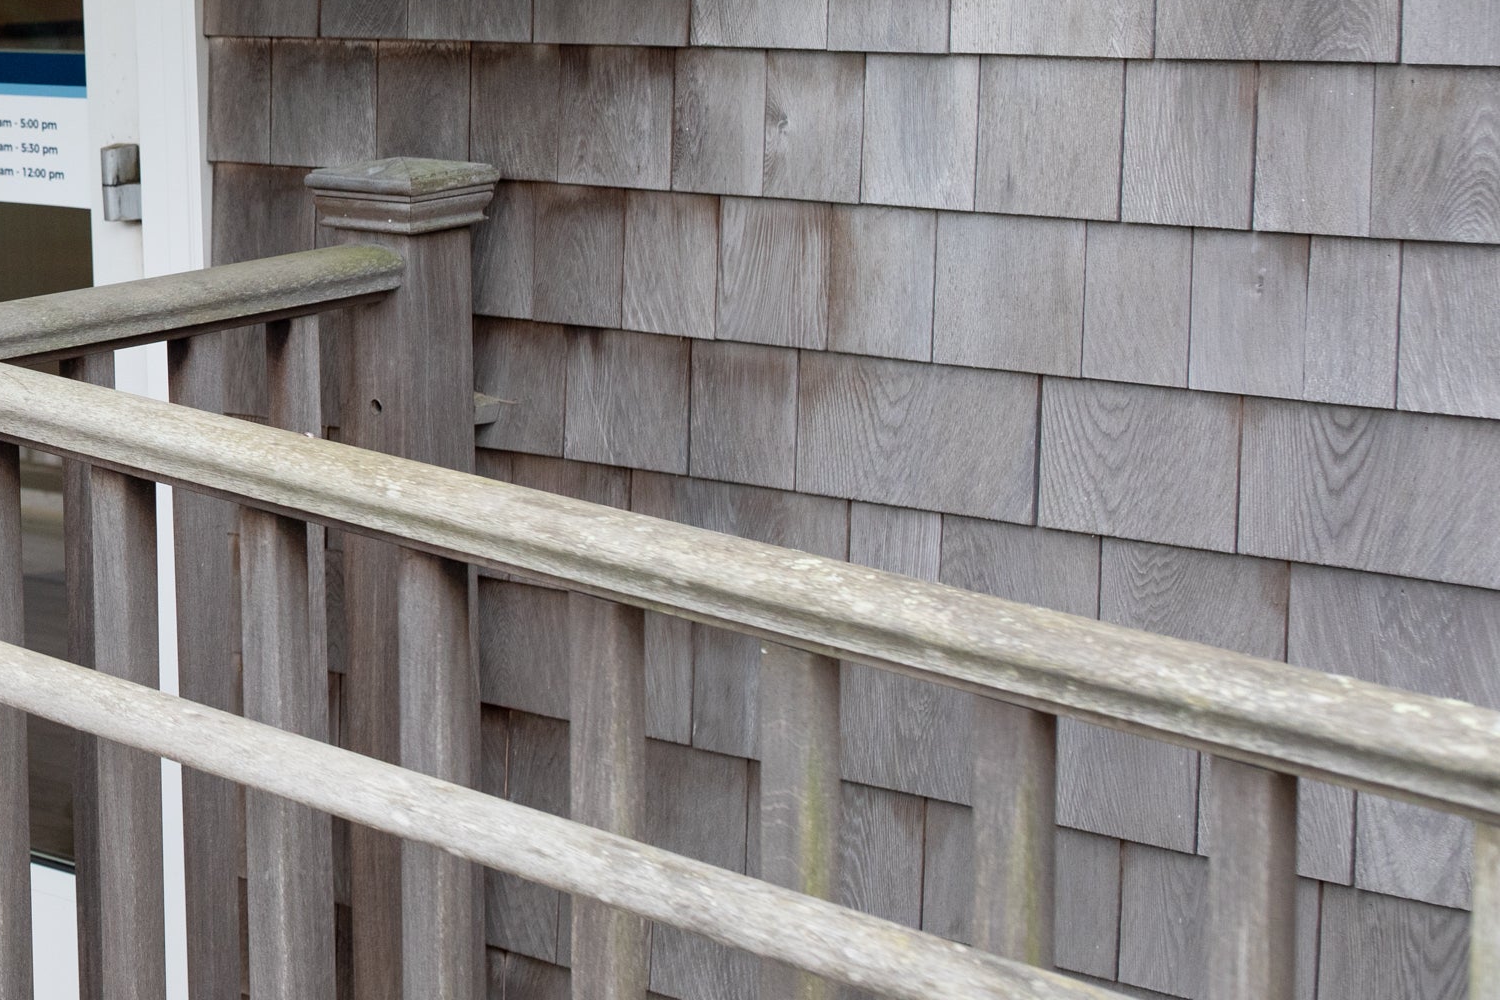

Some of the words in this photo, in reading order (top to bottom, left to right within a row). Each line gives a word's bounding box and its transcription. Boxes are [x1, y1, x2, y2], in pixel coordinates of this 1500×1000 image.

[20, 118, 39, 129] 5:00
[42, 121, 57, 131] pm
[21, 142, 40, 154] 5:30
[42, 146, 58, 156] pm
[0, 168, 14, 176] am
[22, 167, 46, 180] 12:00
[48, 170, 64, 181] pm
